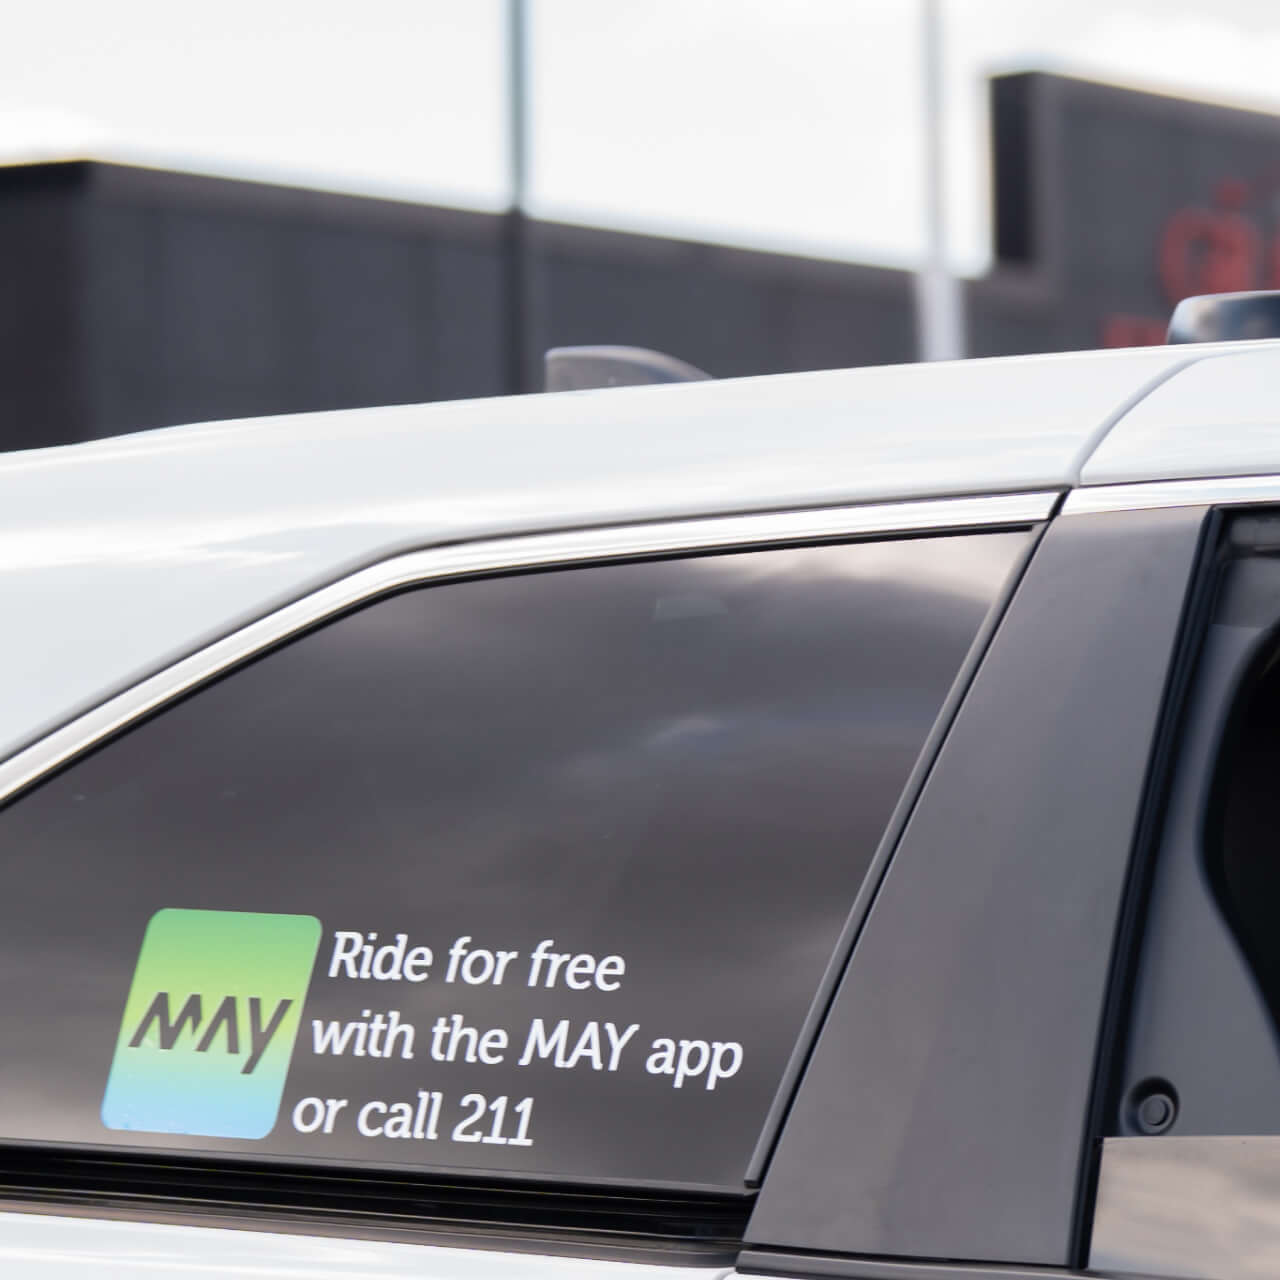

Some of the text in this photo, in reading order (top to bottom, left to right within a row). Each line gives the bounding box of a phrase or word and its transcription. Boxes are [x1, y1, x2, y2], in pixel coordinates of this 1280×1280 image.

[328, 932, 626, 991] Ride for free
[128, 992, 293, 1075] MAY
[312, 1010, 743, 1090] with the MAY app
[292, 1091, 534, 1147] or call 211
